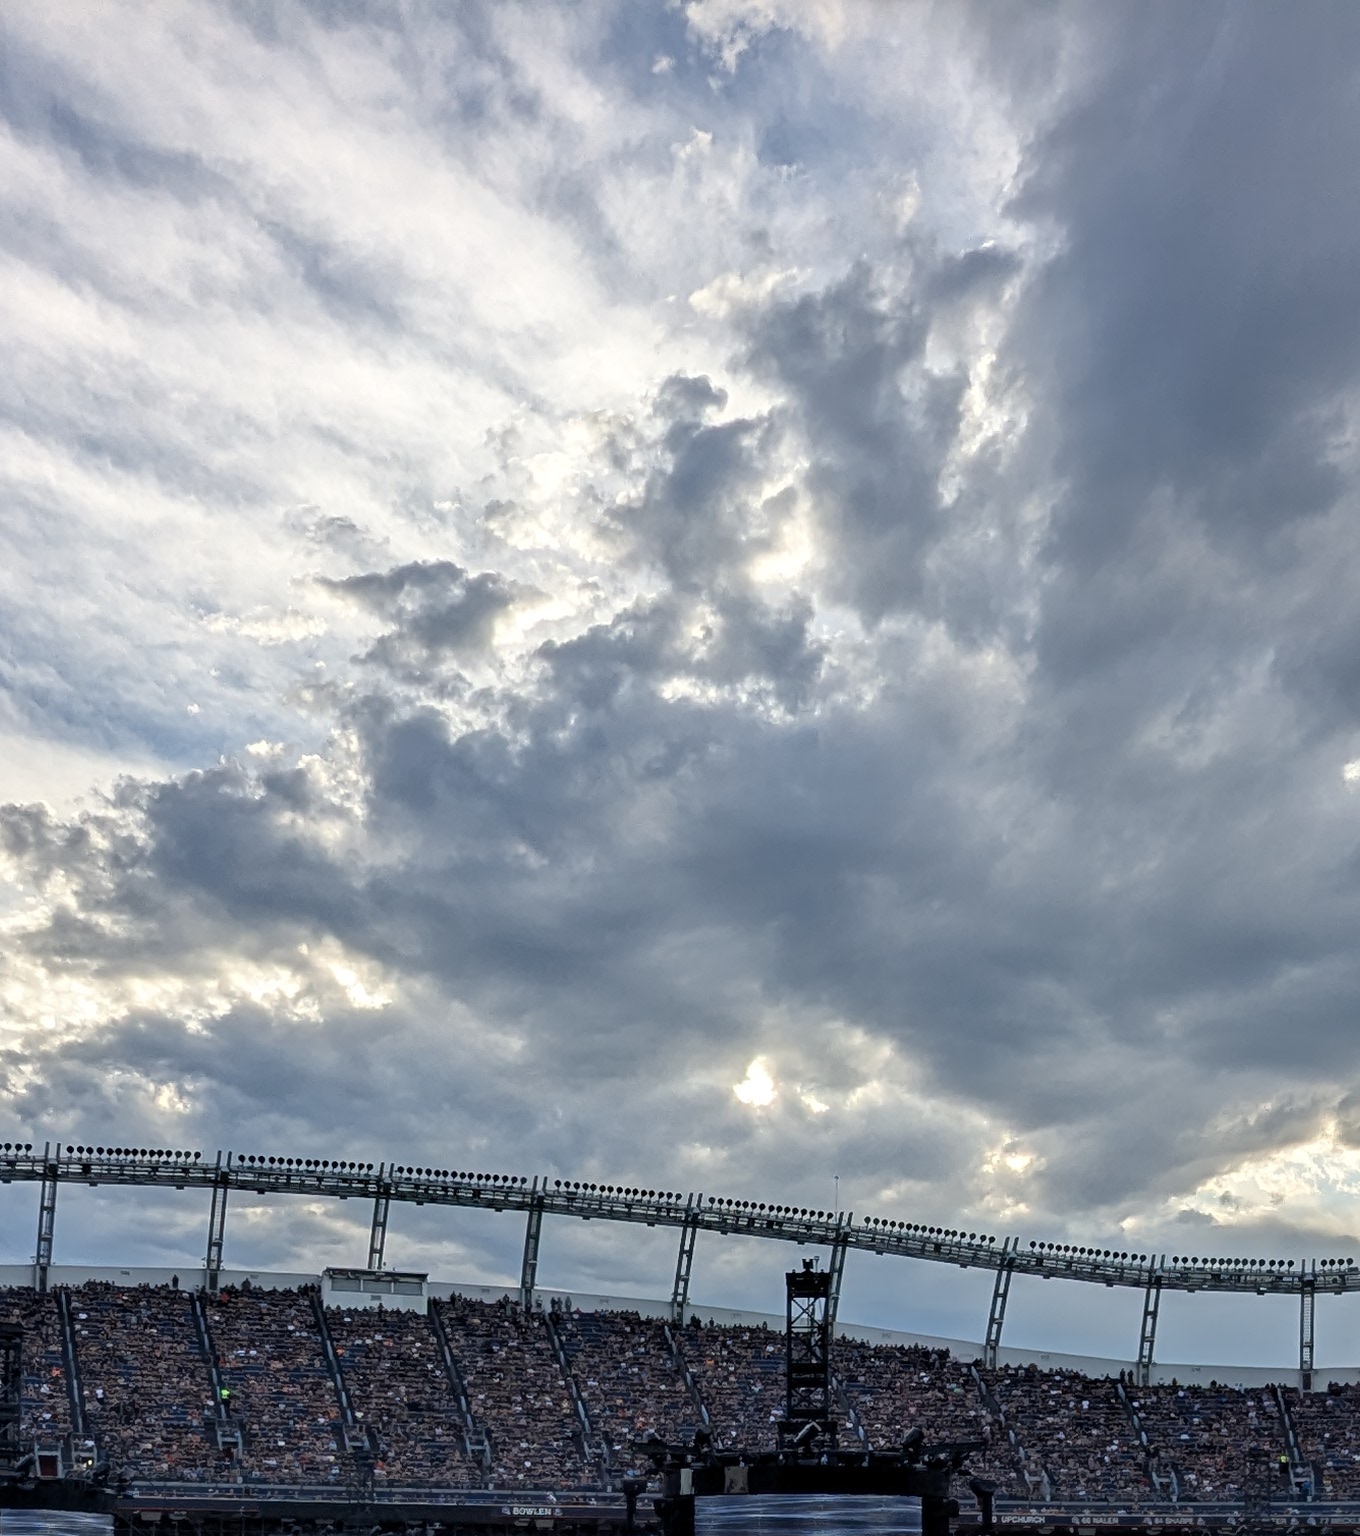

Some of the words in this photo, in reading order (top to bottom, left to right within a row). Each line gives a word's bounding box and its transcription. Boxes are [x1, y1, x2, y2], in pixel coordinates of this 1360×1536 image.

[512, 1507, 552, 1516] BOWLEN
[1001, 1516, 1046, 1524] UPCHURCH
[1092, 1517, 1119, 1525] NALEN
